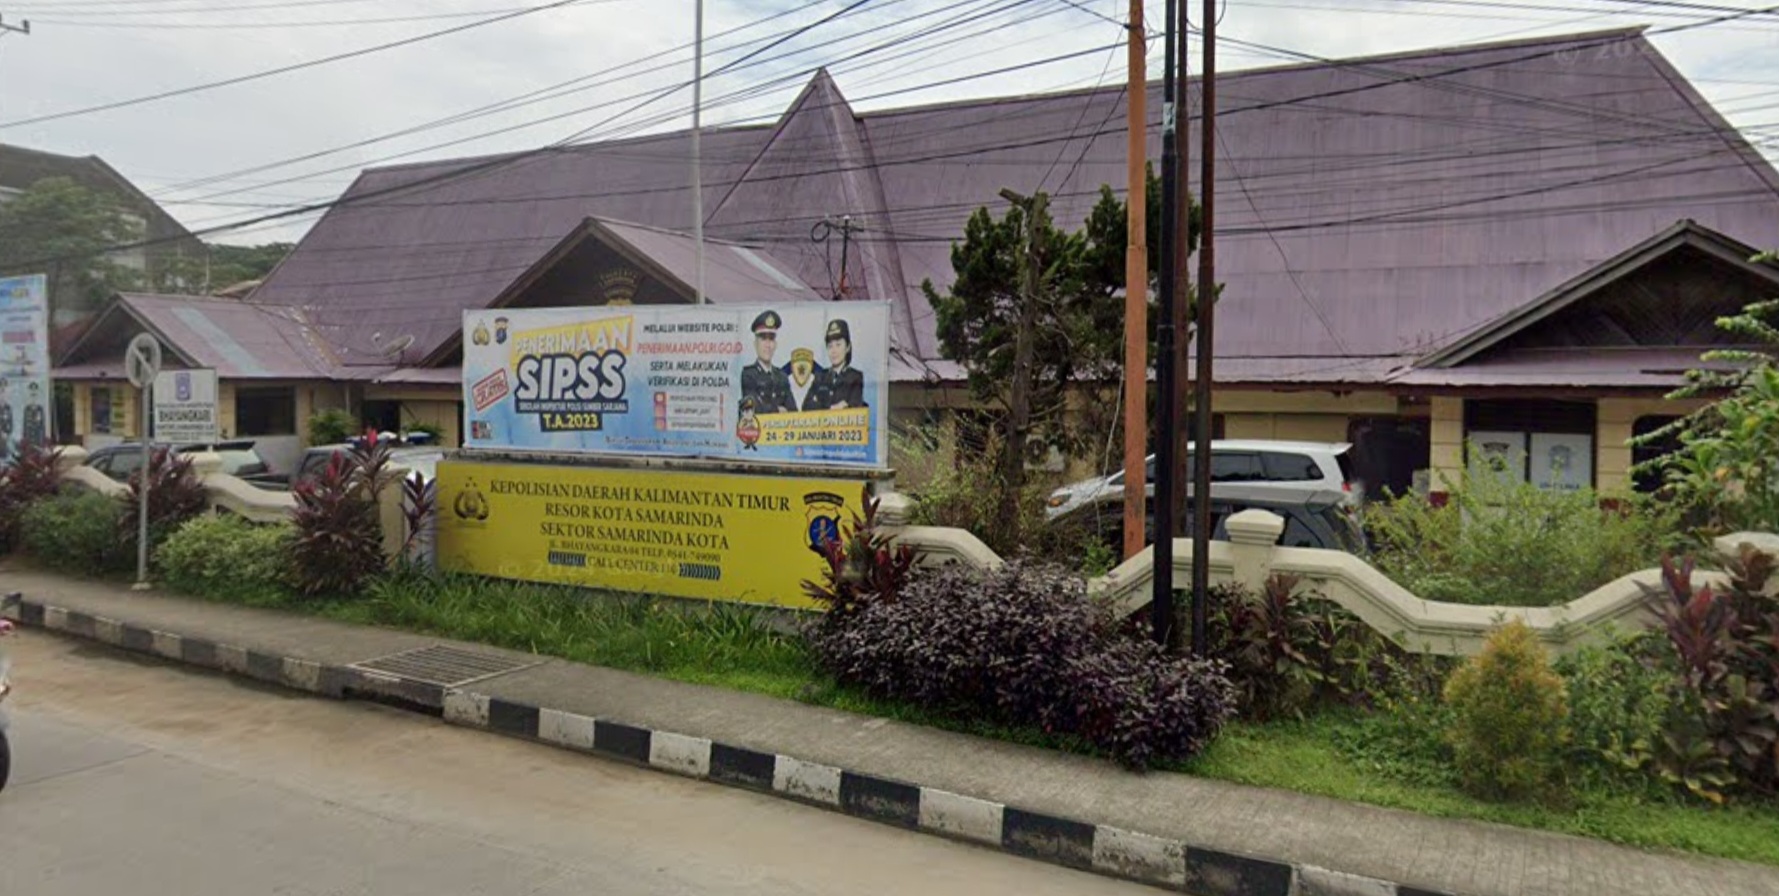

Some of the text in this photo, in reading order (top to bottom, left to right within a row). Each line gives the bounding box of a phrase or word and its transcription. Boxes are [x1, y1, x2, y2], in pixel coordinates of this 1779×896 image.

[643, 324, 676, 333] MELALUI
[678, 323, 710, 332] WEBSITE
[711, 323, 734, 332] POLRI
[515, 321, 632, 356] PENERIMAAN
[650, 361, 728, 371] SERTA MELAKUKAN
[515, 351, 626, 400] SIPSS
[648, 376, 729, 387] VERIFIKASI DI POLDA
[822, 414, 865, 427] ONLINE
[766, 431, 777, 441] 24
[784, 431, 795, 440] 29
[798, 430, 836, 440] JANUARI
[838, 430, 862, 440] 2023
[490, 480, 570, 497] KEPOLISIAN
[572, 483, 631, 501] DAERAH
[634, 487, 734, 508] KALIMANTAN
[737, 493, 790, 511] TIMUR
[545, 502, 724, 528] RESOR KOTA SAMARINDA
[540, 522, 729, 550] SEKTOR SAMARINDA KOTA
[588, 556, 613, 568] CALL
[615, 558, 658, 574] CENTER
